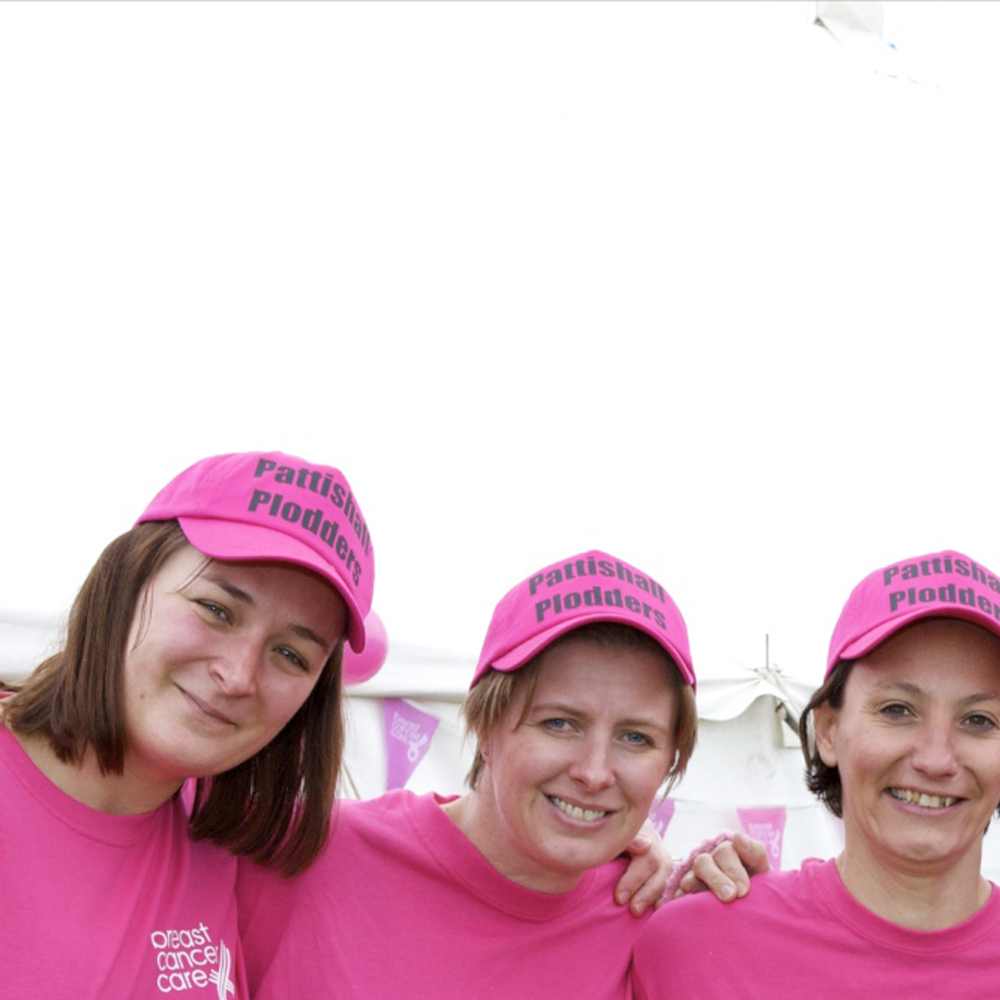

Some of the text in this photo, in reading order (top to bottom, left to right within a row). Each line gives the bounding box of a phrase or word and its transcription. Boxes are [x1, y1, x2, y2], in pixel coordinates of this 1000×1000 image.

[254, 458, 371, 556] Pattishall
[248, 489, 362, 586] Plodders
[529, 556, 666, 604] Pattishall
[535, 586, 667, 630] Plodders
[157, 969, 208, 993] care
